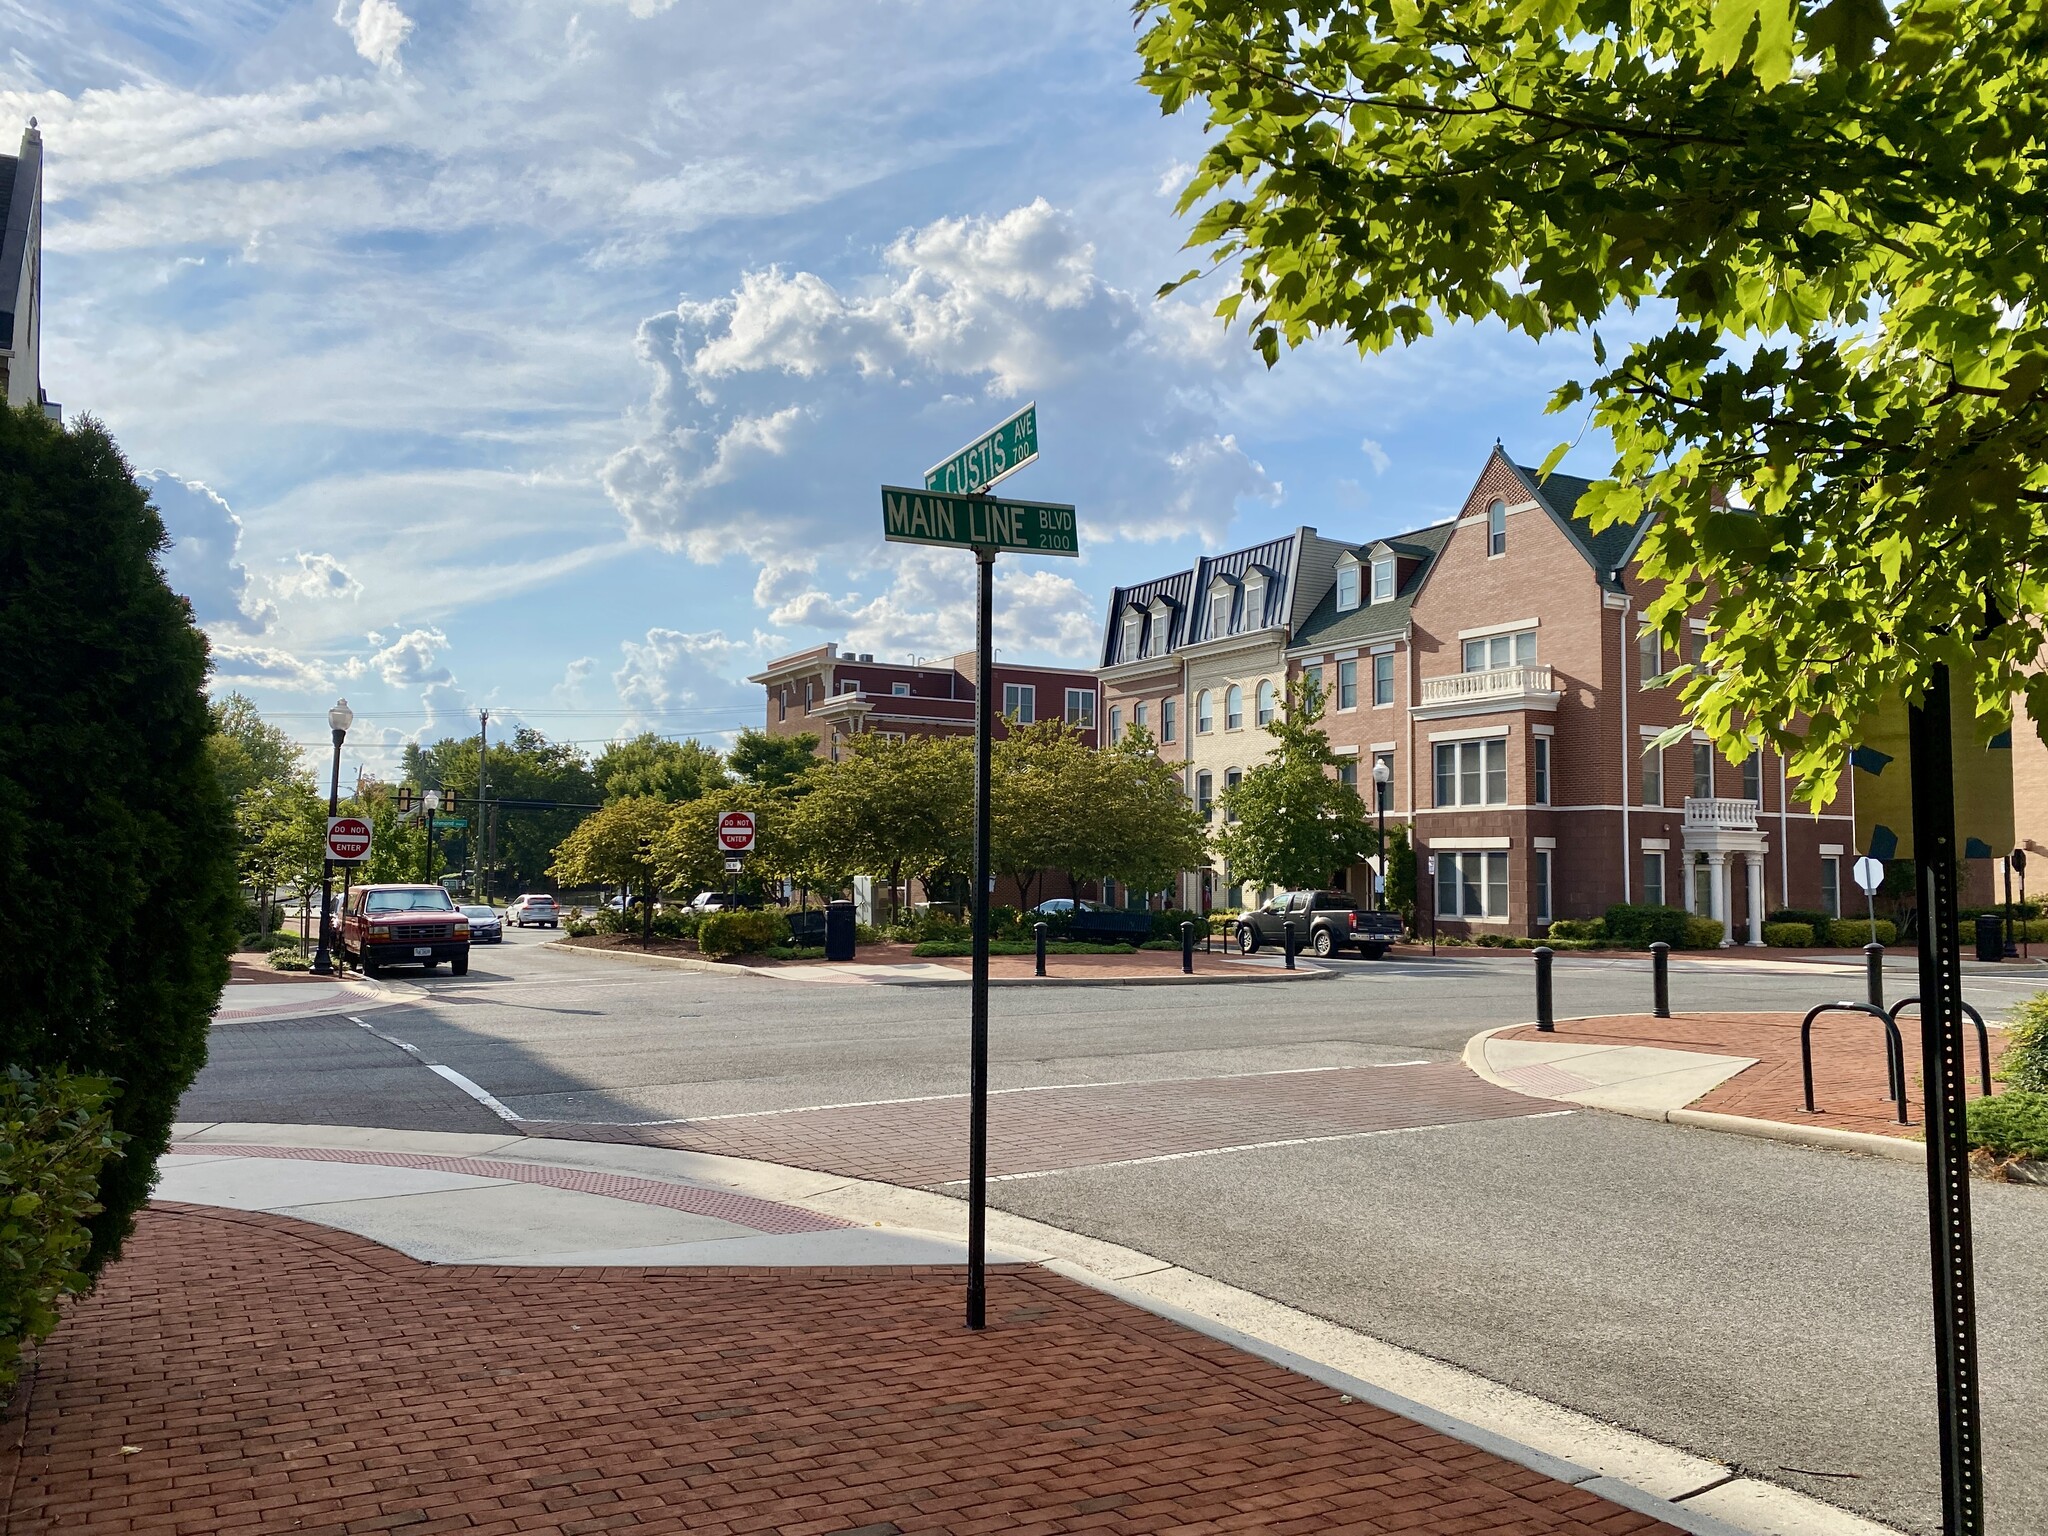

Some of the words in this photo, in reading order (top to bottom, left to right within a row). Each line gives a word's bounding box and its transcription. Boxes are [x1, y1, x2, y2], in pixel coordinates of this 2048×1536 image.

[945, 432, 1006, 494] CUSTIS
[1014, 412, 1034, 443] AVE
[1012, 441, 1029, 464] 700
[886, 493, 956, 539] MAIN
[968, 503, 1028, 545] LINE
[1039, 509, 1072, 531] BLVD
[1039, 534, 1070, 550] 2100
